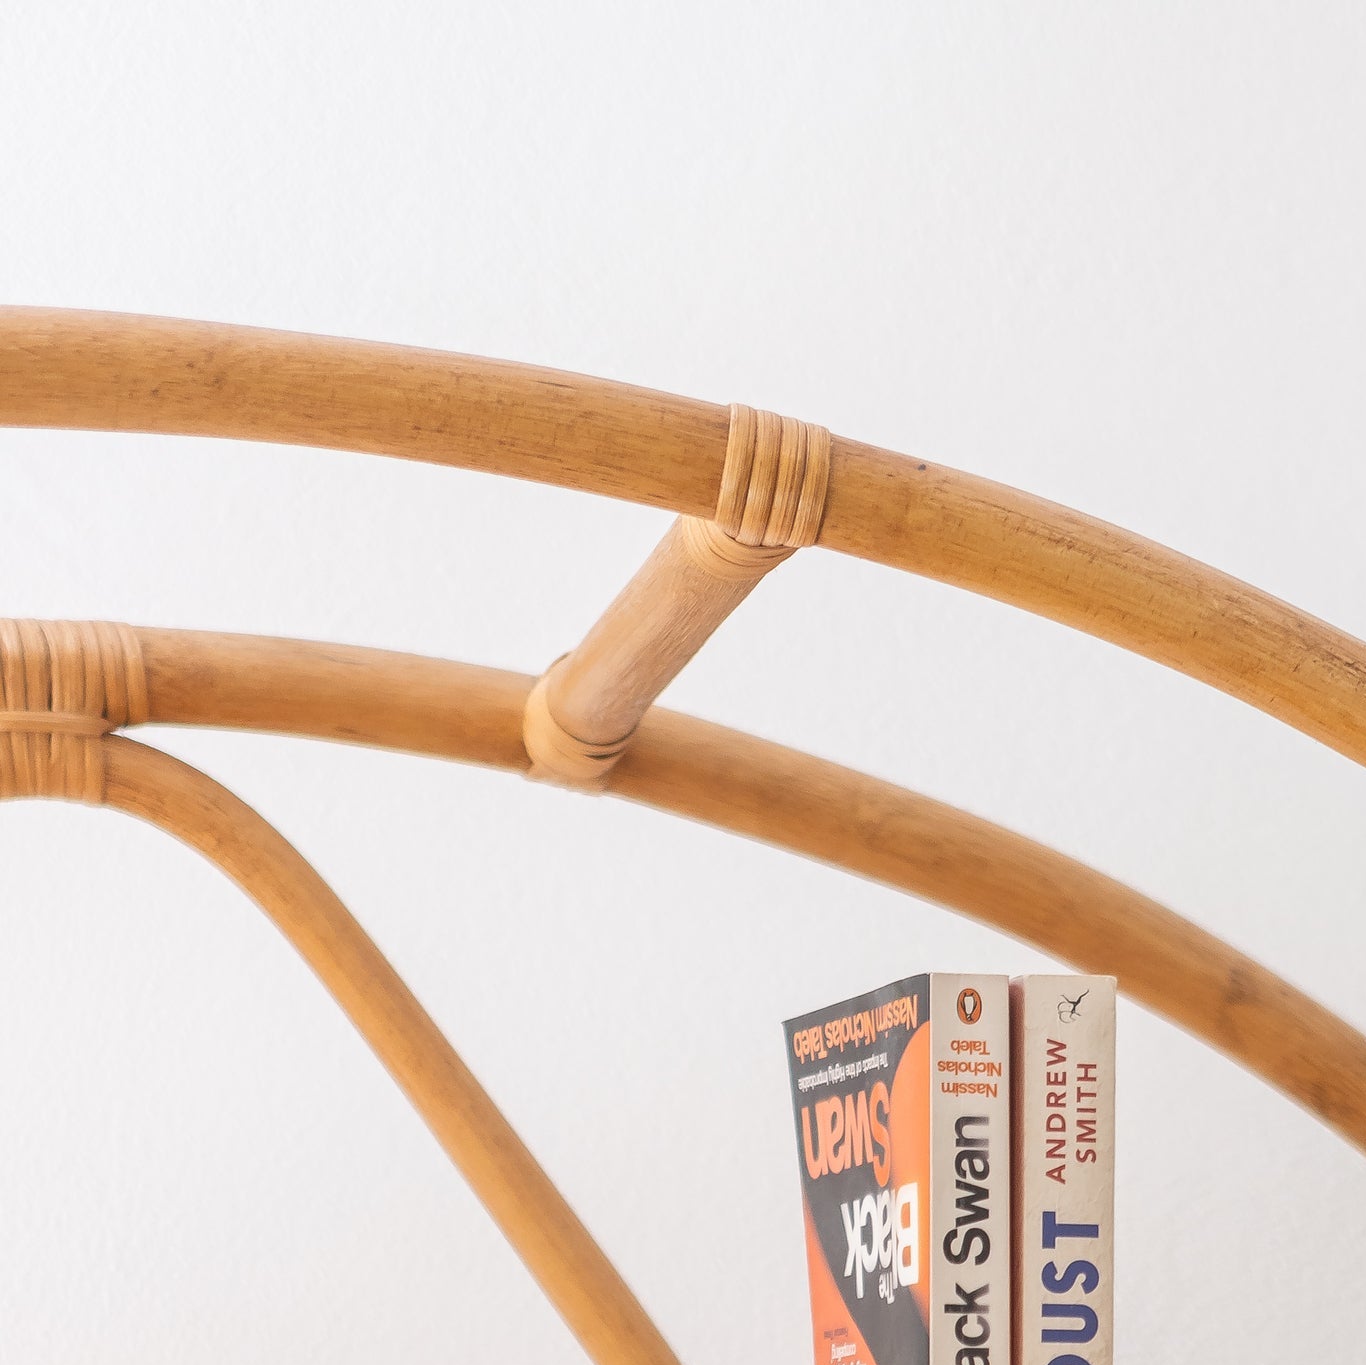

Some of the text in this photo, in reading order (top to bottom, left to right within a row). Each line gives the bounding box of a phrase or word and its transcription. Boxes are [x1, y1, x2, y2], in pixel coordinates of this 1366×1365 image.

[793, 994, 918, 1064] Nassim Nicholas Taleb
[937, 1060, 1002, 1077] Nicholas
[950, 1040, 990, 1055] Taleb
[941, 1082, 997, 1098] Nassim
[1046, 1039, 1067, 1184] ANDREW
[1076, 1063, 1097, 1163] SMITH
[801, 1080, 891, 1187] Swan
[943, 1114, 990, 1265] Swan
[840, 1182, 919, 1299] Black
[879, 1272, 895, 1305] The
